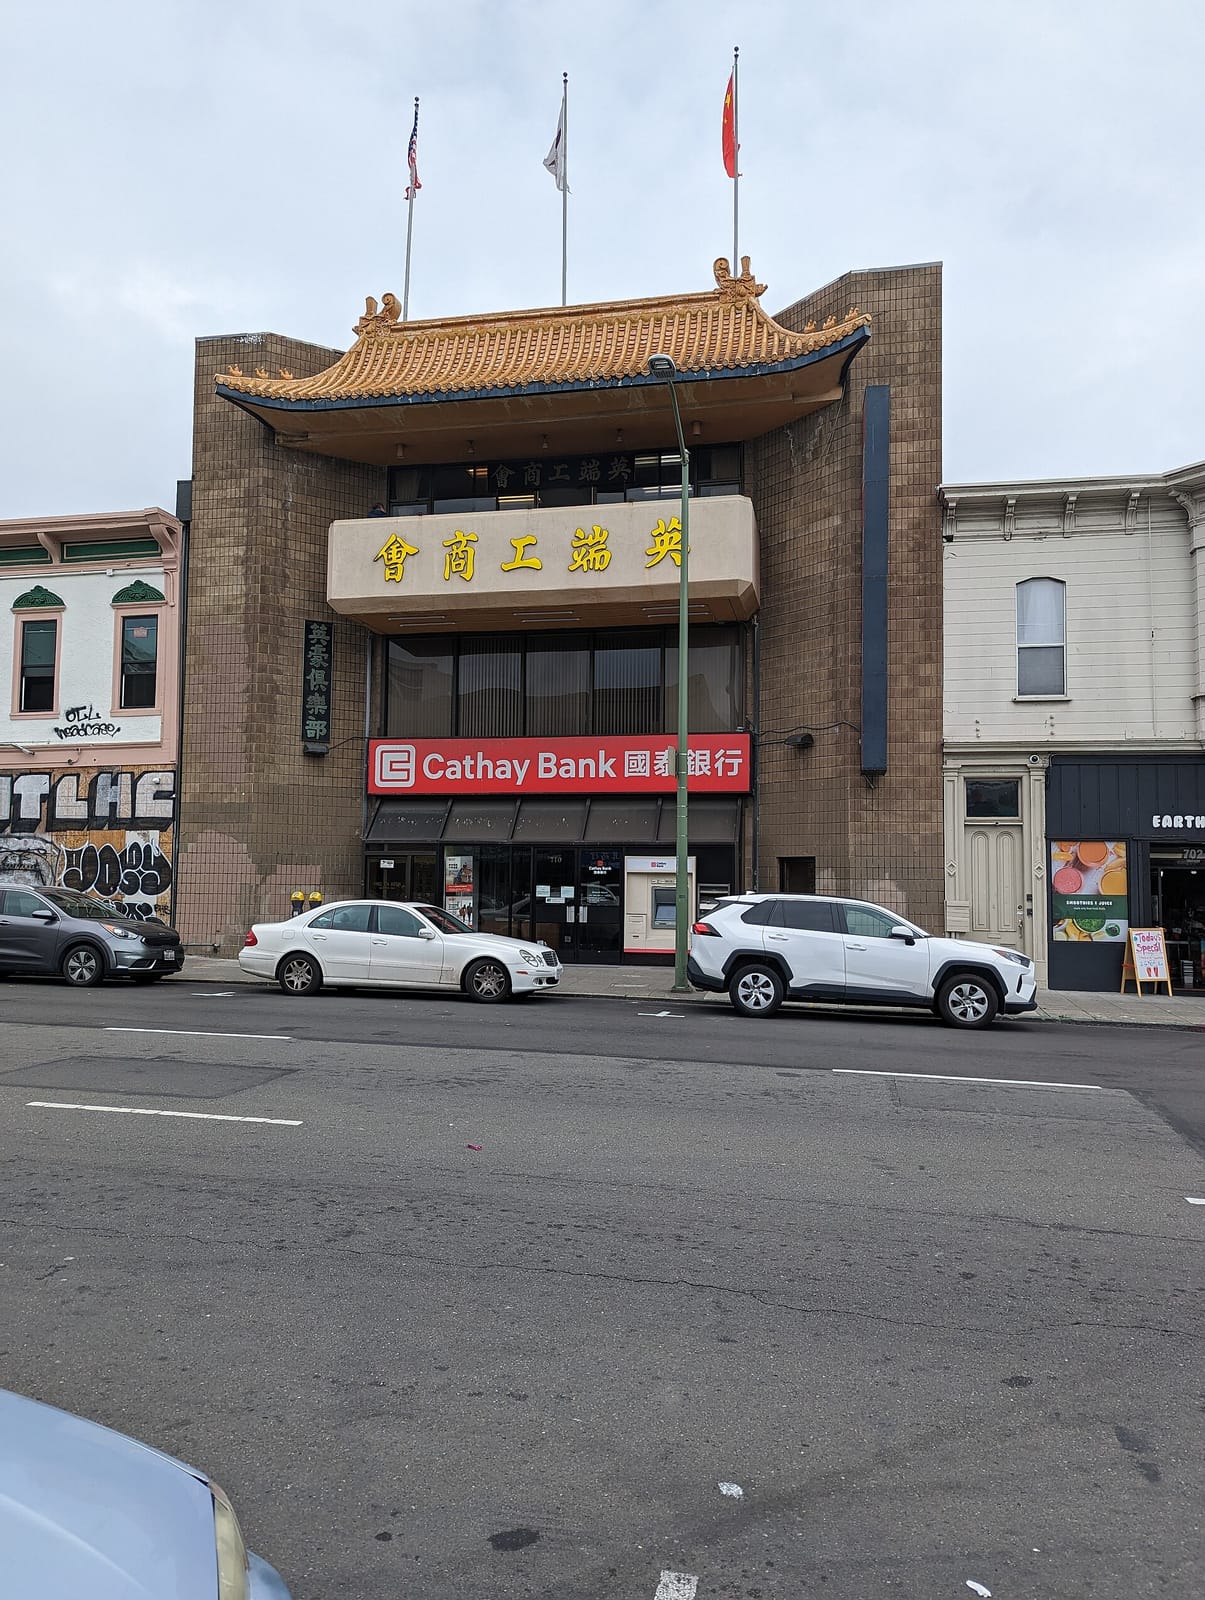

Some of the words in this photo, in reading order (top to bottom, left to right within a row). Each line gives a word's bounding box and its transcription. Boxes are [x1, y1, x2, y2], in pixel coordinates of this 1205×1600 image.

[422, 751, 530, 785] Cathay
[538, 749, 617, 779] Bank
[1152, 815, 1205, 829] EARTH
